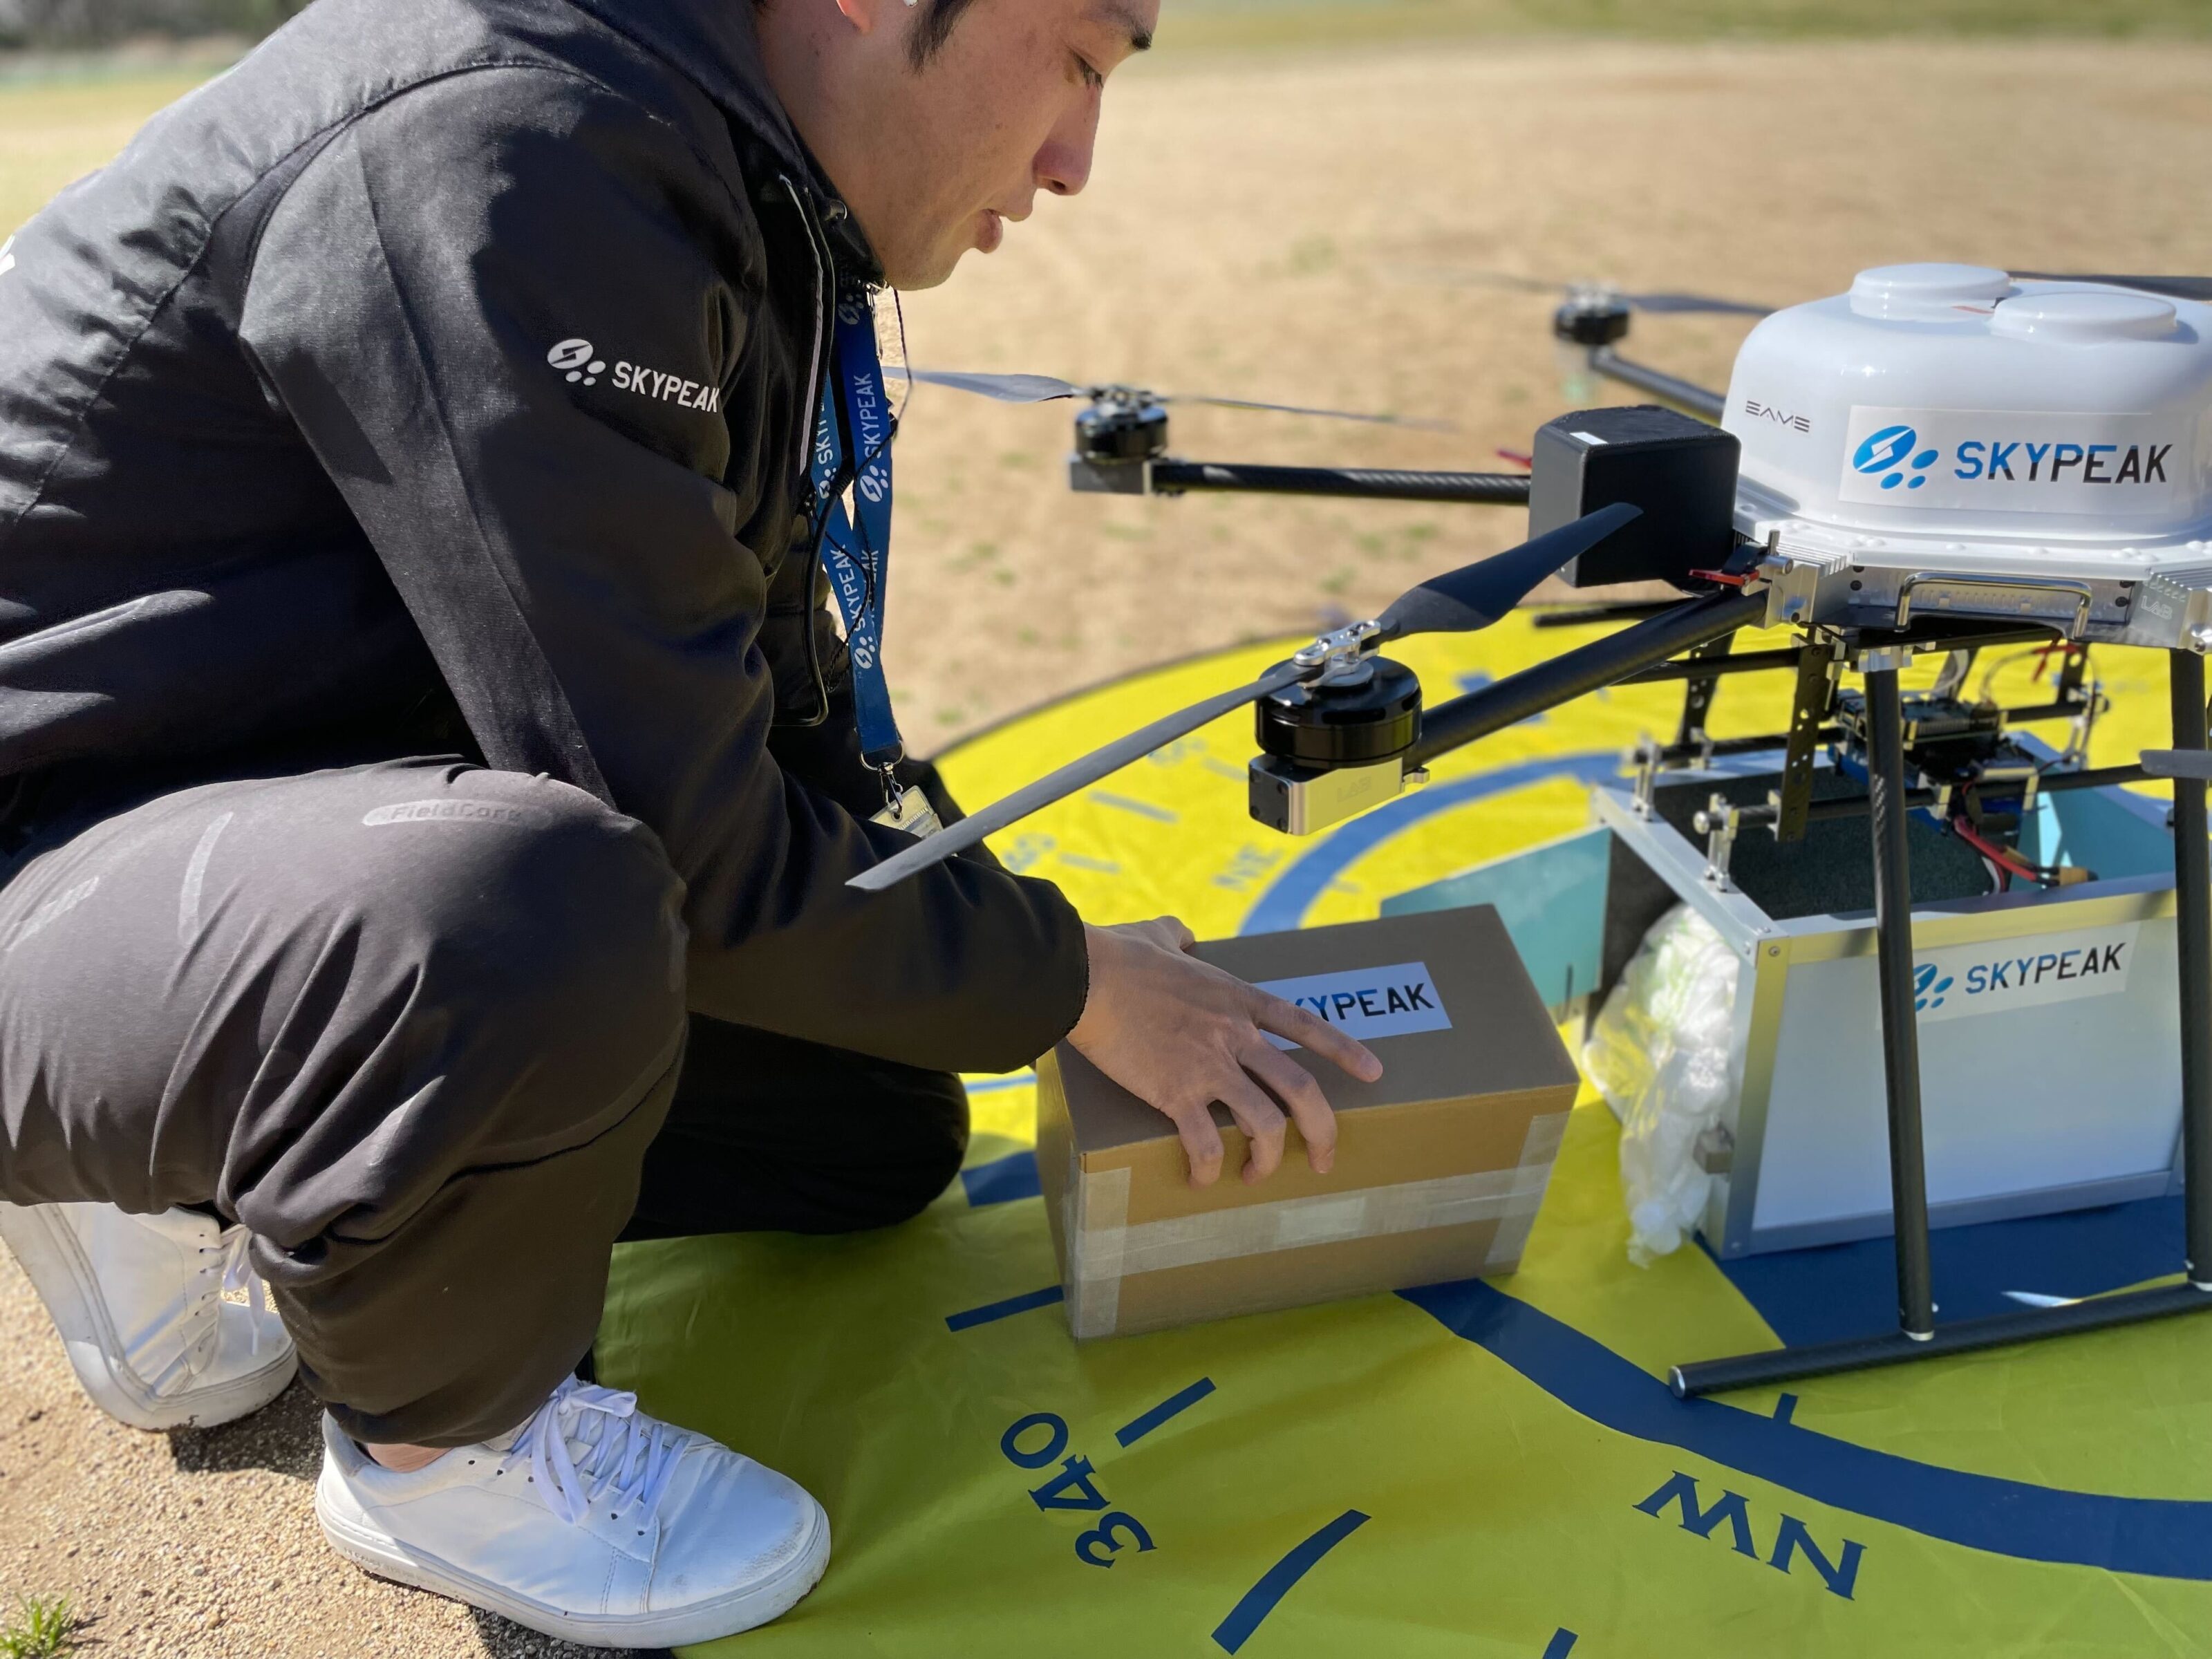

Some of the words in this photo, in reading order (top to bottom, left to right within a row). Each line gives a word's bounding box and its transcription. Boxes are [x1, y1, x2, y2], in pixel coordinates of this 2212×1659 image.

[611, 361, 720, 413] SKYPEAK
[854, 373, 881, 459] SKYPEAK
[1954, 441, 2174, 484] SKYPEAK
[830, 544, 865, 632] SKYPEAK
[2141, 595, 2173, 620] LAB
[1965, 943, 2126, 994] SKYPEAK
[1000, 1412, 1158, 1568] 340
[1632, 1470, 1868, 1601] NW
